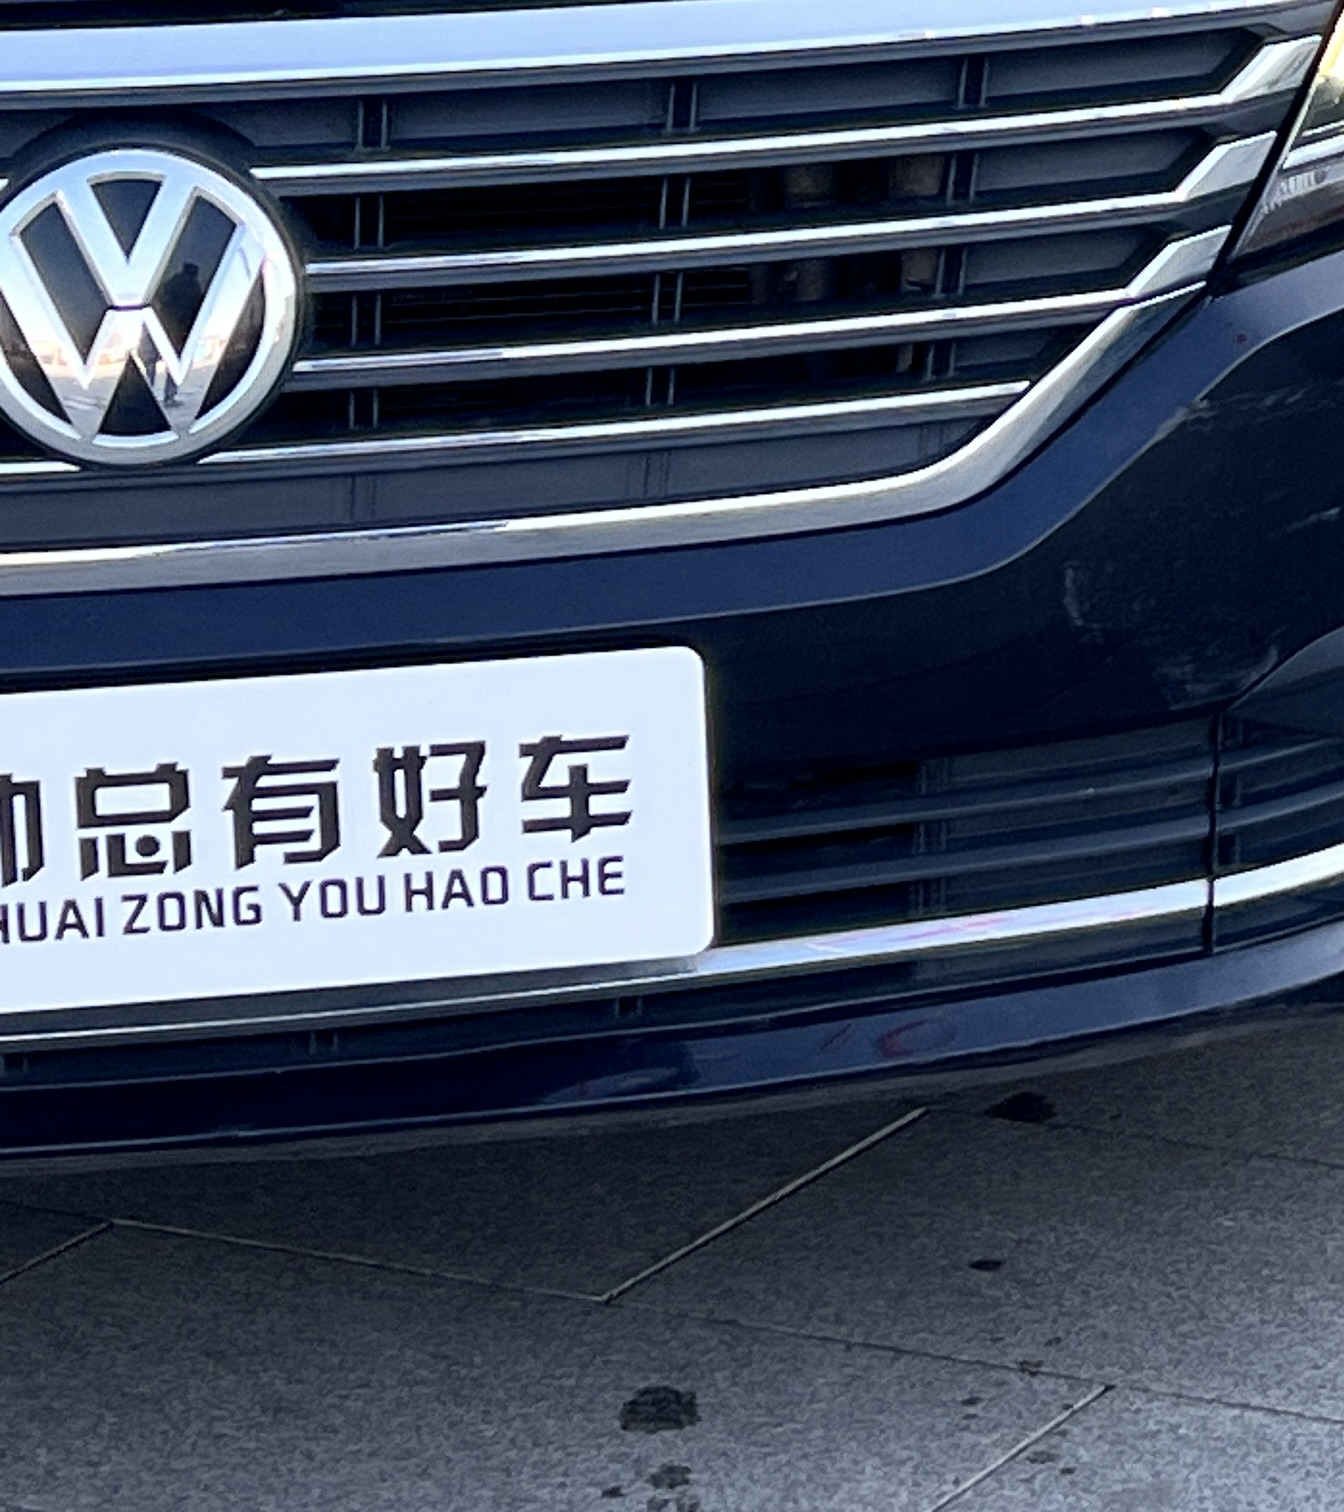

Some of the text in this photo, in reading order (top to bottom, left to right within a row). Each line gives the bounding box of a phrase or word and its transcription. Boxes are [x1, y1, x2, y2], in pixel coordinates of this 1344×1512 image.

[0, 156, 288, 458] VW
[121, 885, 263, 935] ZONG
[278, 875, 387, 923] YOU
[404, 865, 511, 913] HAO
[527, 854, 626, 903] CHE
